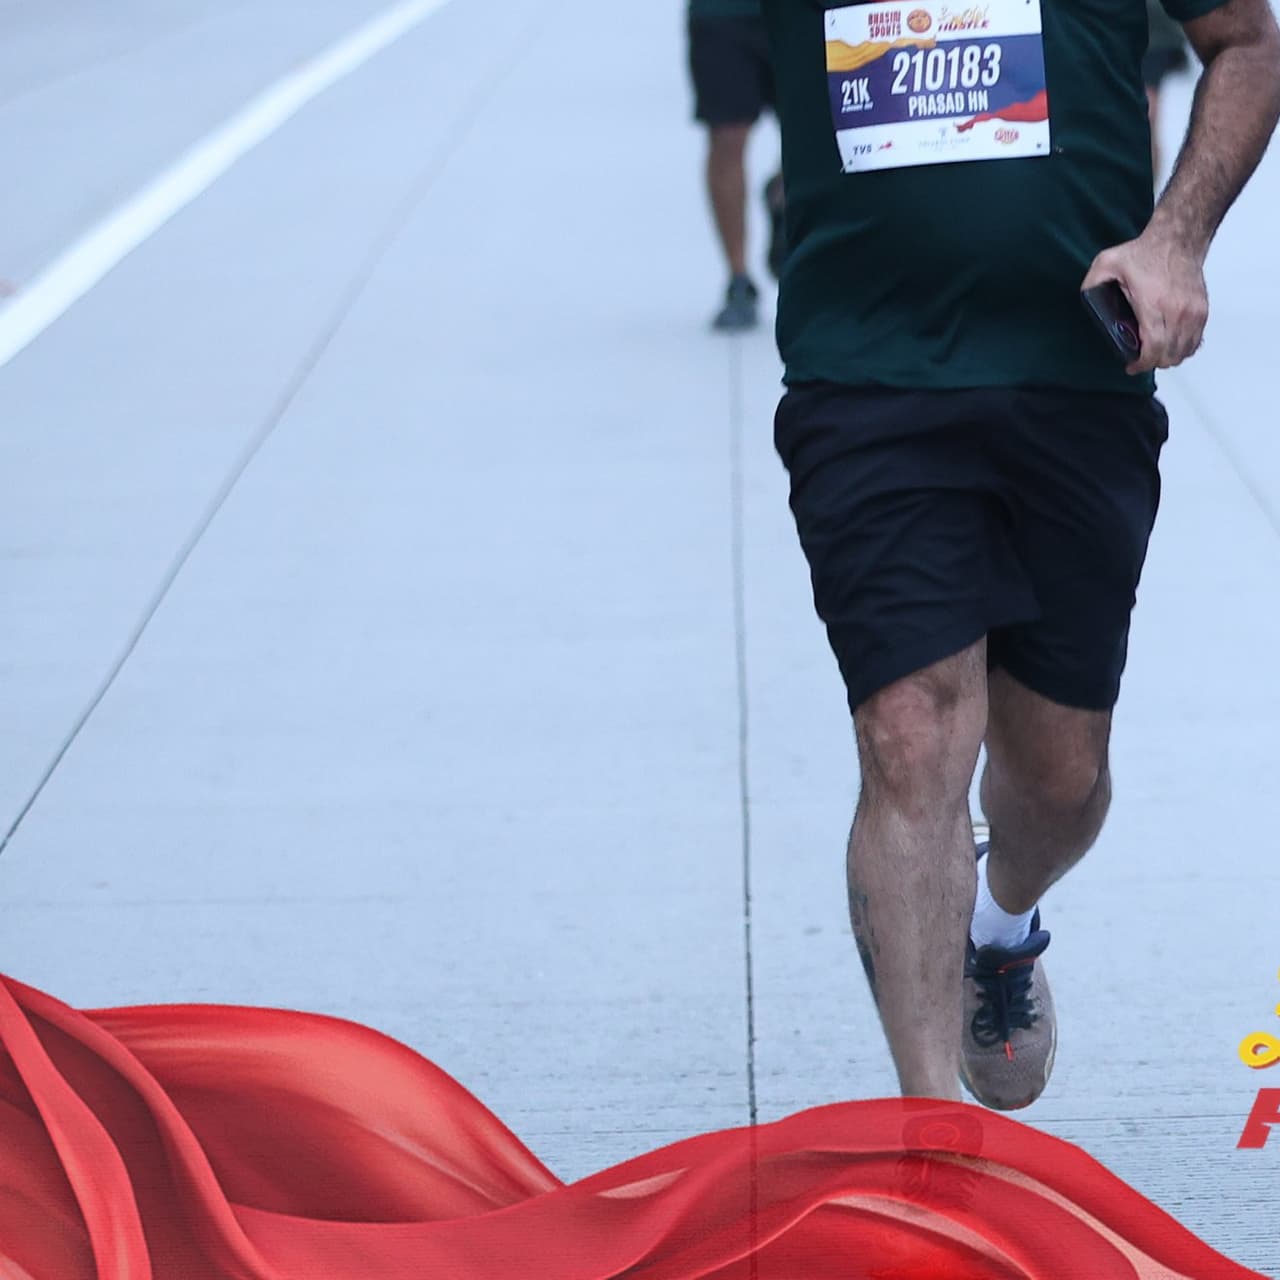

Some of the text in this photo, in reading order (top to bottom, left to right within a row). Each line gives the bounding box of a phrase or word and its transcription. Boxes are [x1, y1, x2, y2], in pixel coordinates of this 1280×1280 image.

[891, 43, 1002, 95] 210183
[841, 78, 870, 105] 21K
[908, 90, 989, 117] PRASAD HN
[852, 144, 873, 156] TVS
